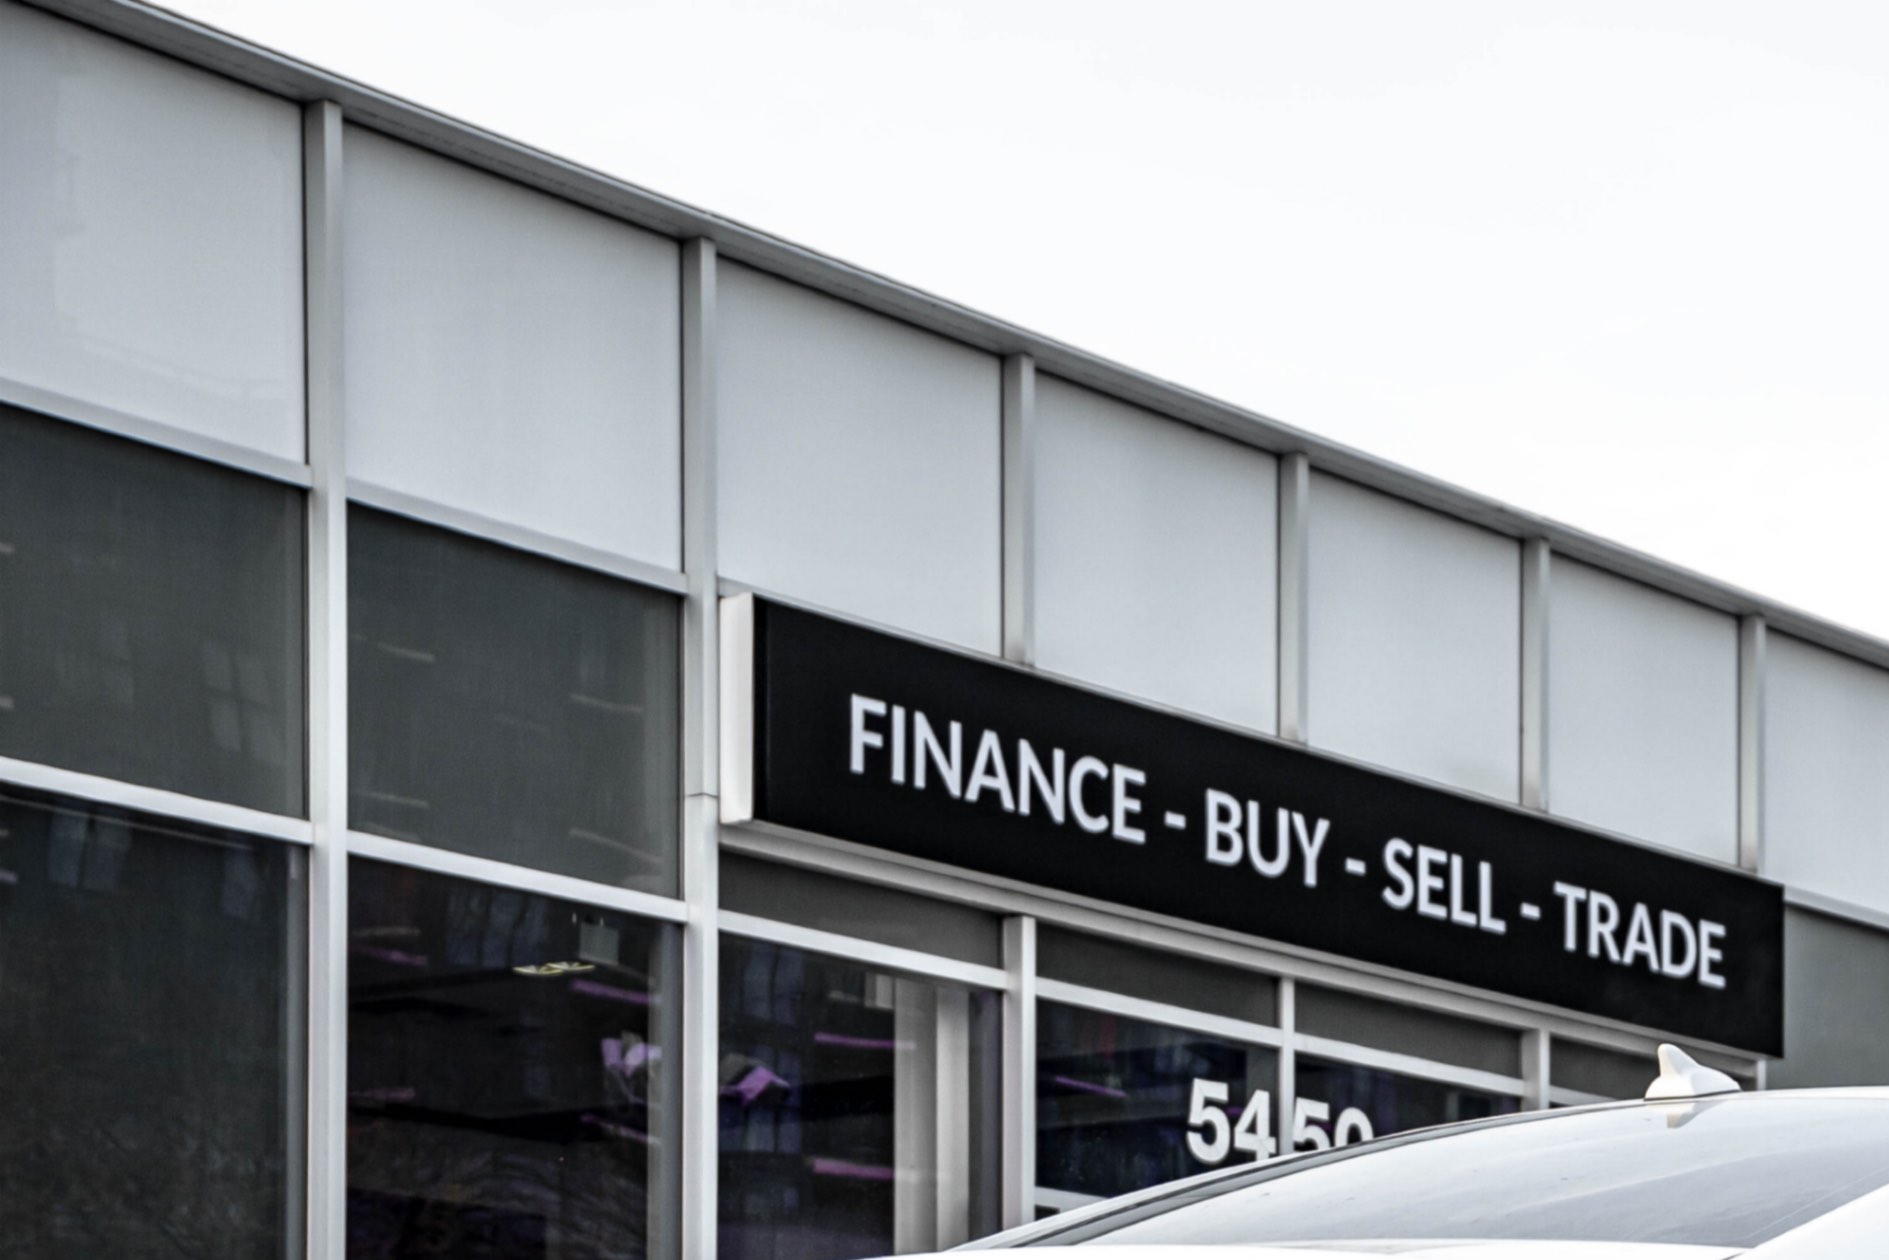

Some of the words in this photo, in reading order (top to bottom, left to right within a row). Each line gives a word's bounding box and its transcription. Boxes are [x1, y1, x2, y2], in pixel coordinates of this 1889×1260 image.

[849, 692, 1147, 845] FINANCE
[1205, 787, 1331, 888] BUY
[1382, 837, 1507, 934] SELL
[1553, 880, 1727, 989] TRADE
